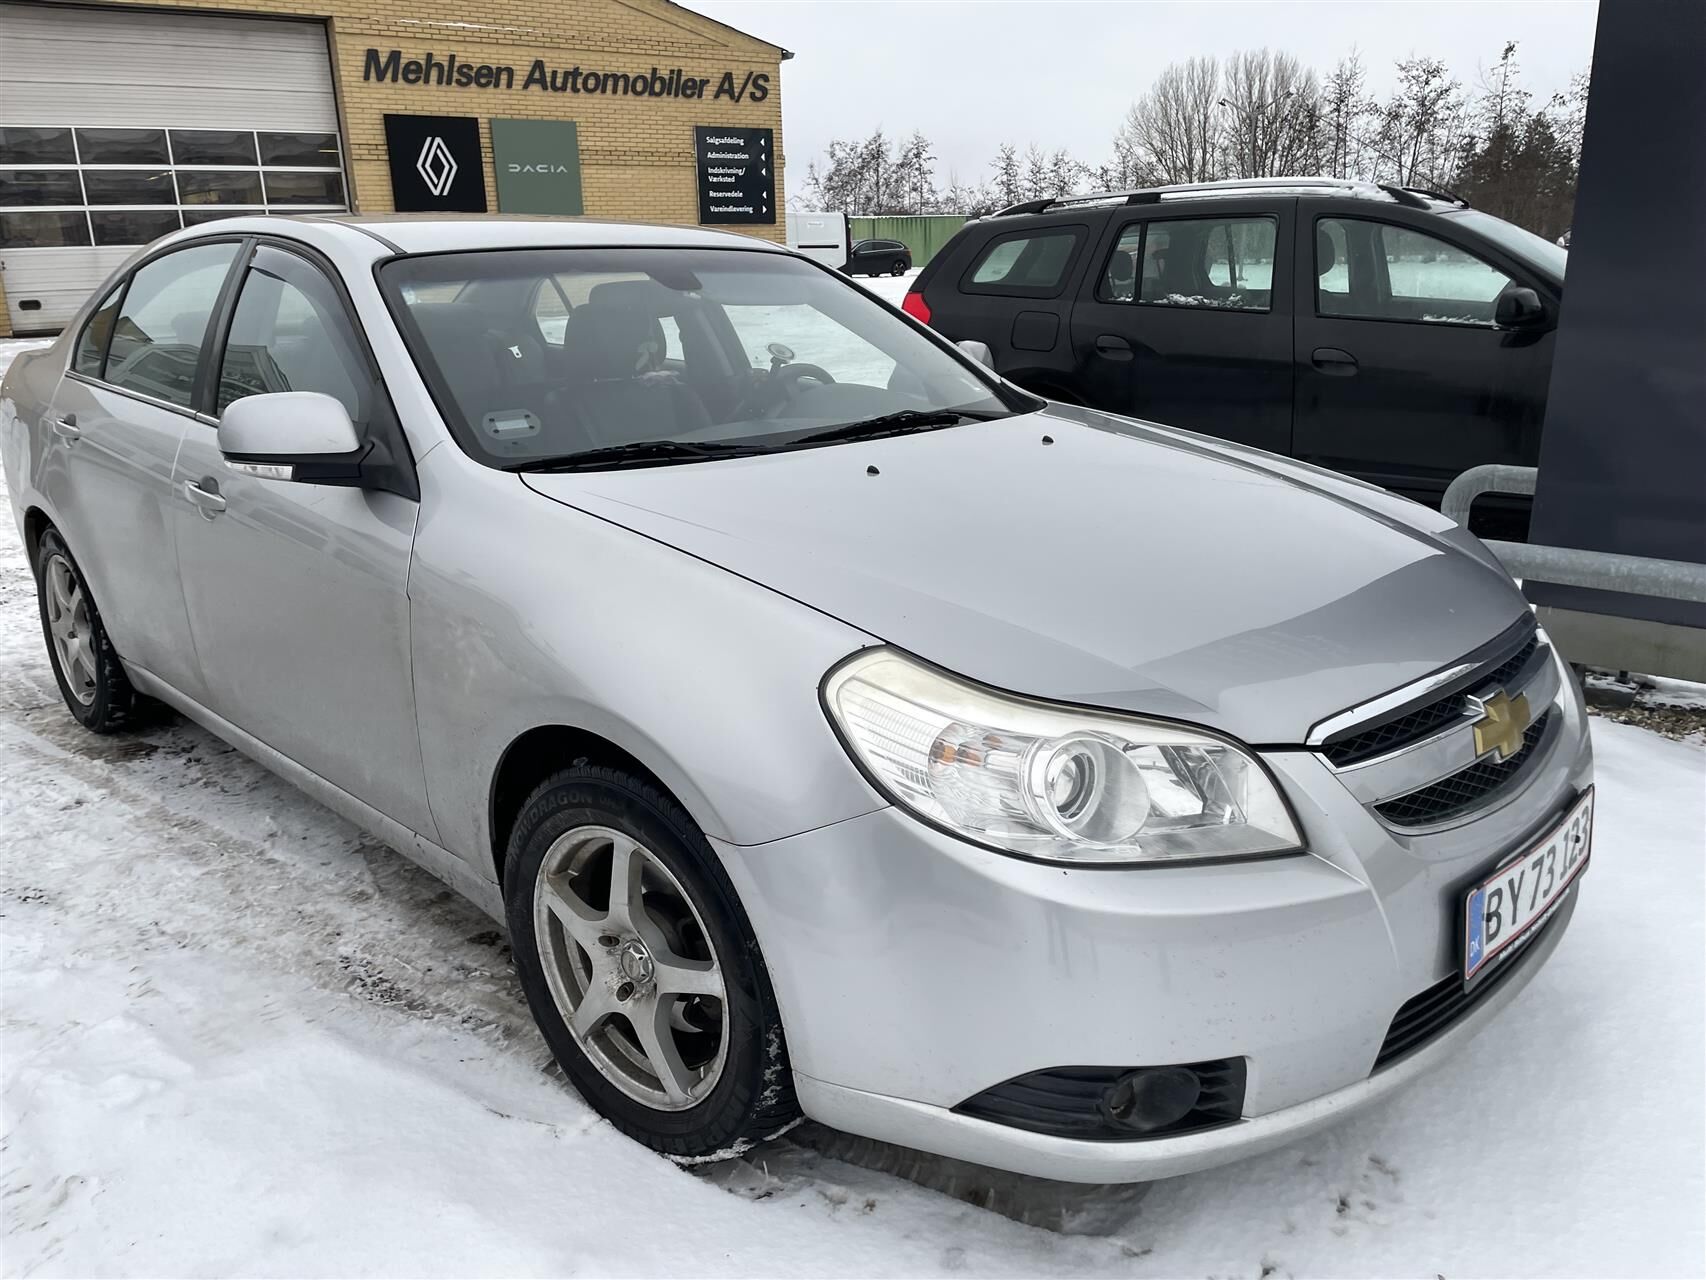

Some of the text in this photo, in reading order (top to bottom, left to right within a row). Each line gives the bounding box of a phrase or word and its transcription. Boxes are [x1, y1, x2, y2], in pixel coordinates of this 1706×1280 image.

[363, 48, 770, 103] Mehlsen Automobiler A/S
[706, 136, 744, 145] Salgsafdeling
[508, 163, 568, 173] DACIA
[710, 205, 753, 213] Vareindlevering
[1485, 869, 1525, 945] BY
[1530, 845, 1557, 911] 73
[1560, 805, 1590, 881] 123
